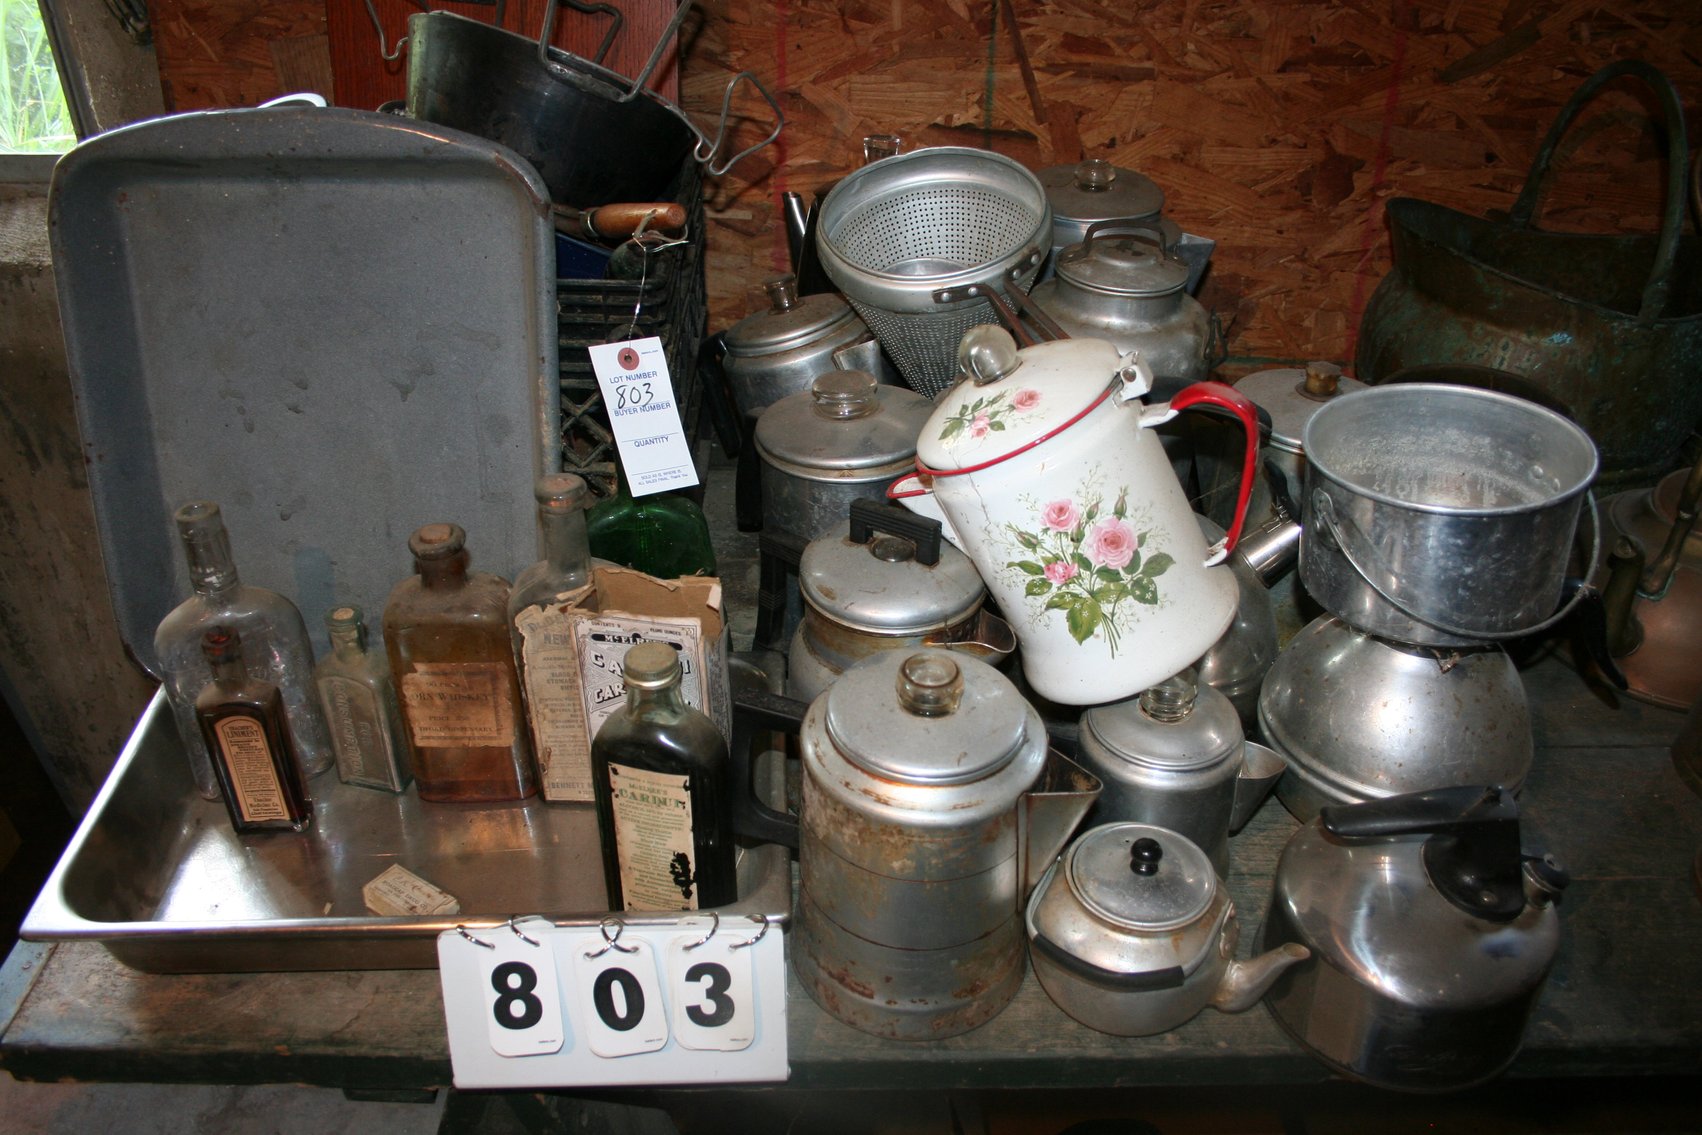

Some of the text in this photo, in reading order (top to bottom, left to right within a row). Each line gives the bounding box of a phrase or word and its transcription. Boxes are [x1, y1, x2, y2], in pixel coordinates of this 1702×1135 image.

[609, 370, 658, 384] LOT NUMBER
[615, 382, 654, 409] 803
[614, 402, 671, 417] BUYER NUMBER
[633, 435, 669, 448] QUANTITY
[227, 730, 258, 738] LINIMENT
